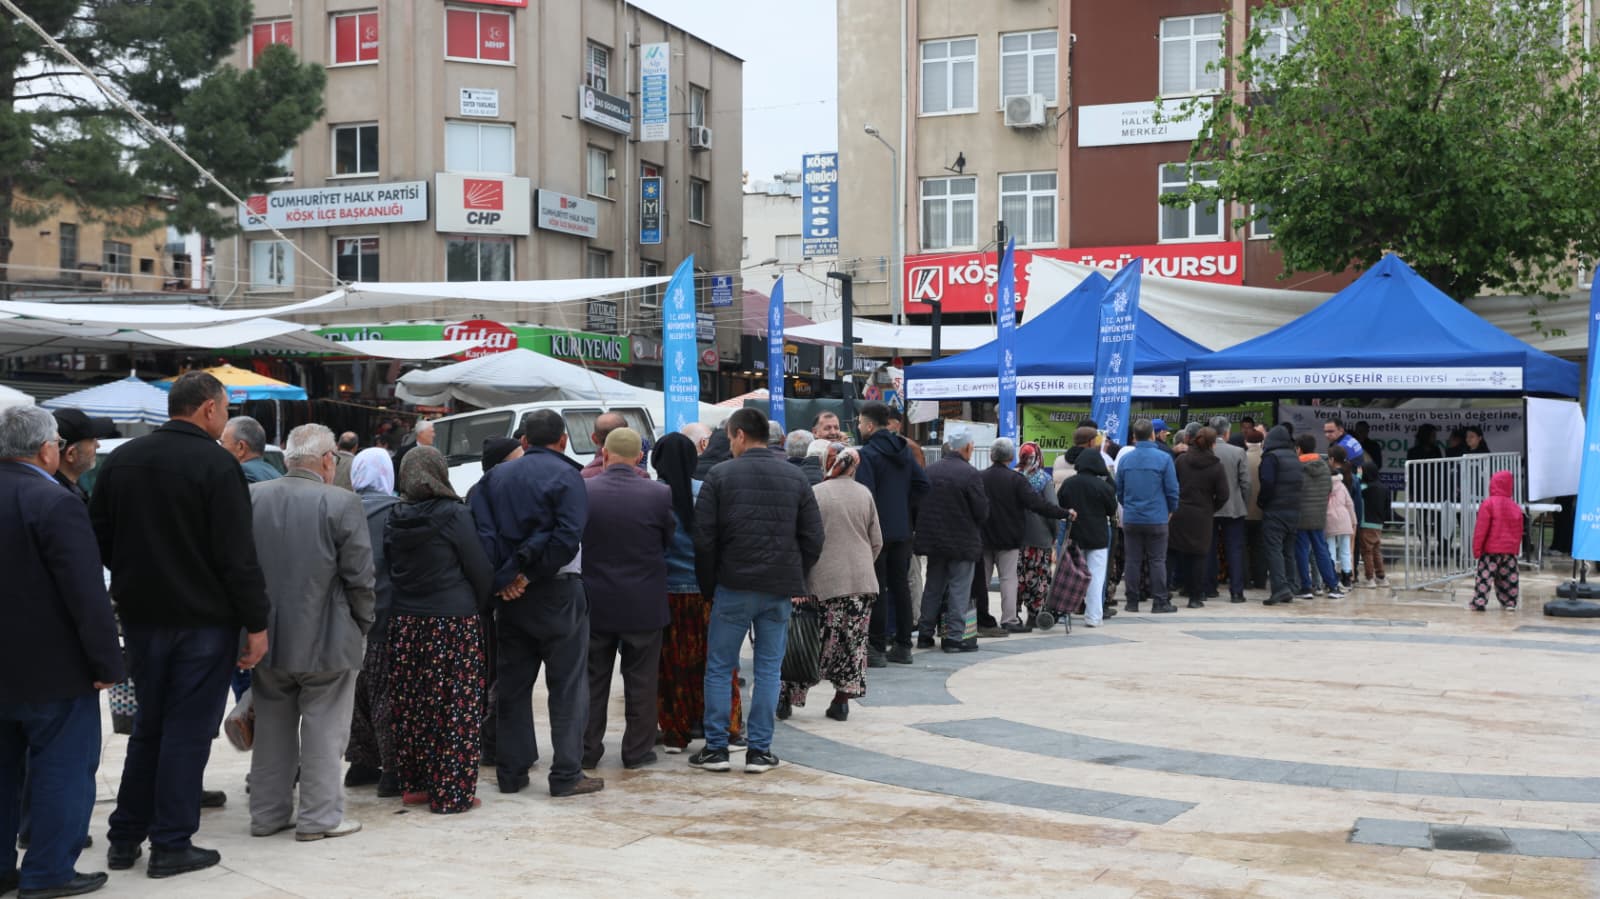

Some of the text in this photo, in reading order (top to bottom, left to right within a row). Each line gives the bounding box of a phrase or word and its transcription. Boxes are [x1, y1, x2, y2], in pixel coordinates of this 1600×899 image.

[1121, 117, 1149, 127] HALK
[1121, 126, 1168, 137] MERKEZİ
[806, 155, 835, 169] KÖŞK
[805, 169, 837, 184] SÜRÜCÜ
[271, 185, 419, 208] CUMHURİYET HALK PARTİSİ
[286, 203, 403, 223] KÖŞK İLÇE BAŞKANLIĞI
[644, 199, 658, 214] İYİ
[811, 184, 831, 236] KURSU
[467, 212, 500, 225] CHP
[1143, 255, 1237, 277] KURSU
[444, 325, 516, 348] Tutar
[551, 335, 622, 361] KURUYEMİŞ
[1016, 380, 1064, 391] YÜKŞEHİR
[1271, 376, 1301, 384] AYDIN
[1305, 372, 1382, 385] BÜYÜKŞEHİR
[1387, 373, 1448, 383] BELEDİYESİ
[1314, 409, 1523, 422] Yerel Tohum, zengin besin değerine,
[1367, 423, 1400, 432] enetik
[1496, 425, 1510, 433] ve
